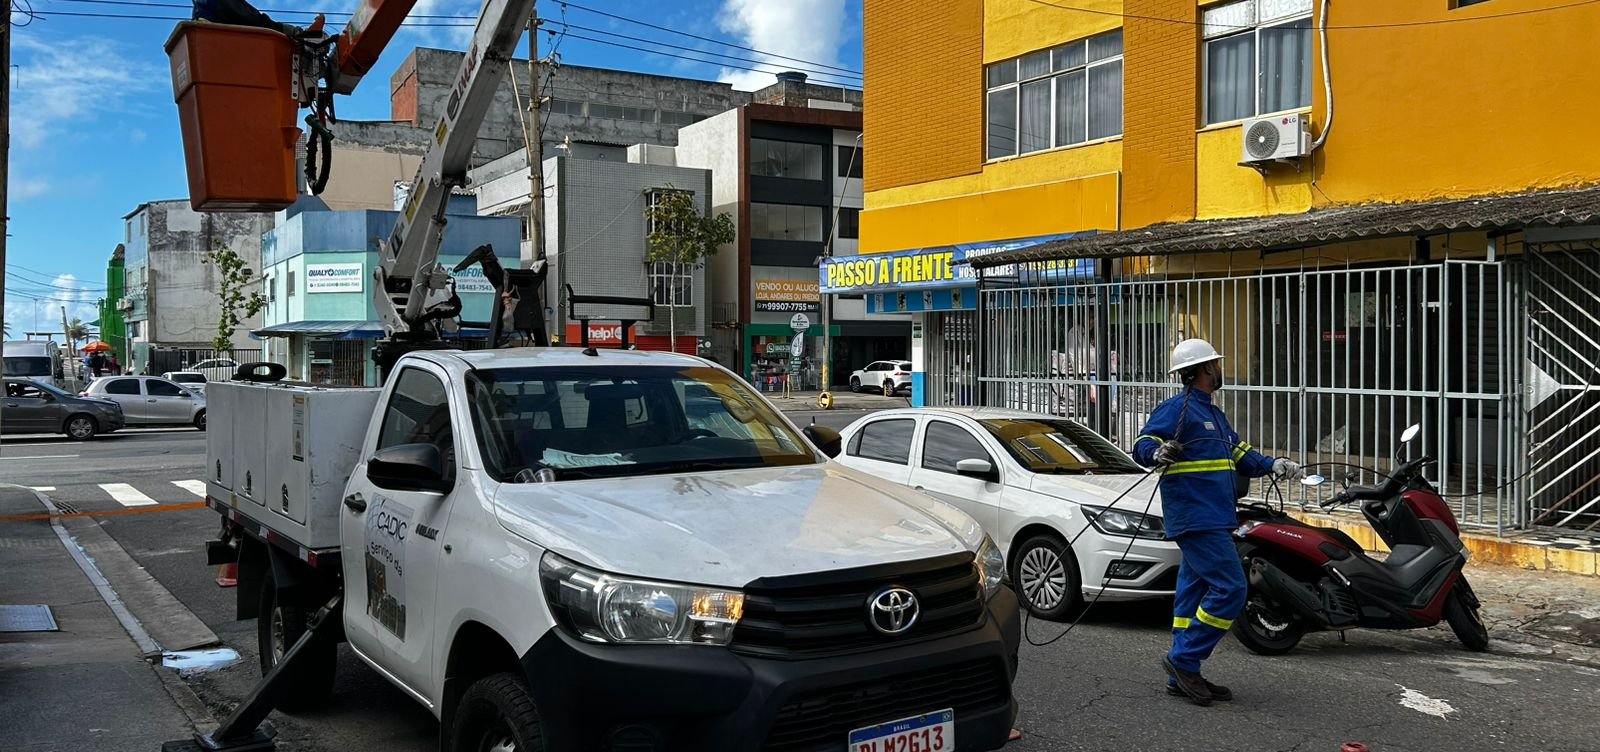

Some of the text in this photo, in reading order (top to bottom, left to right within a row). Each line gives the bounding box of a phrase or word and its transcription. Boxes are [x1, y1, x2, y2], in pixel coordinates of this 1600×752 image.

[827, 252, 954, 288] PASSO A FRENTE
[755, 283, 819, 292] VENDO OU ALUGO
[770, 293, 793, 301] ANDARES
[793, 293, 802, 301] OU
[767, 302, 808, 312] 99907-7755
[588, 327, 614, 341] help!
[377, 511, 407, 540] CADIC
[893, 723, 911, 732] BRASIL
